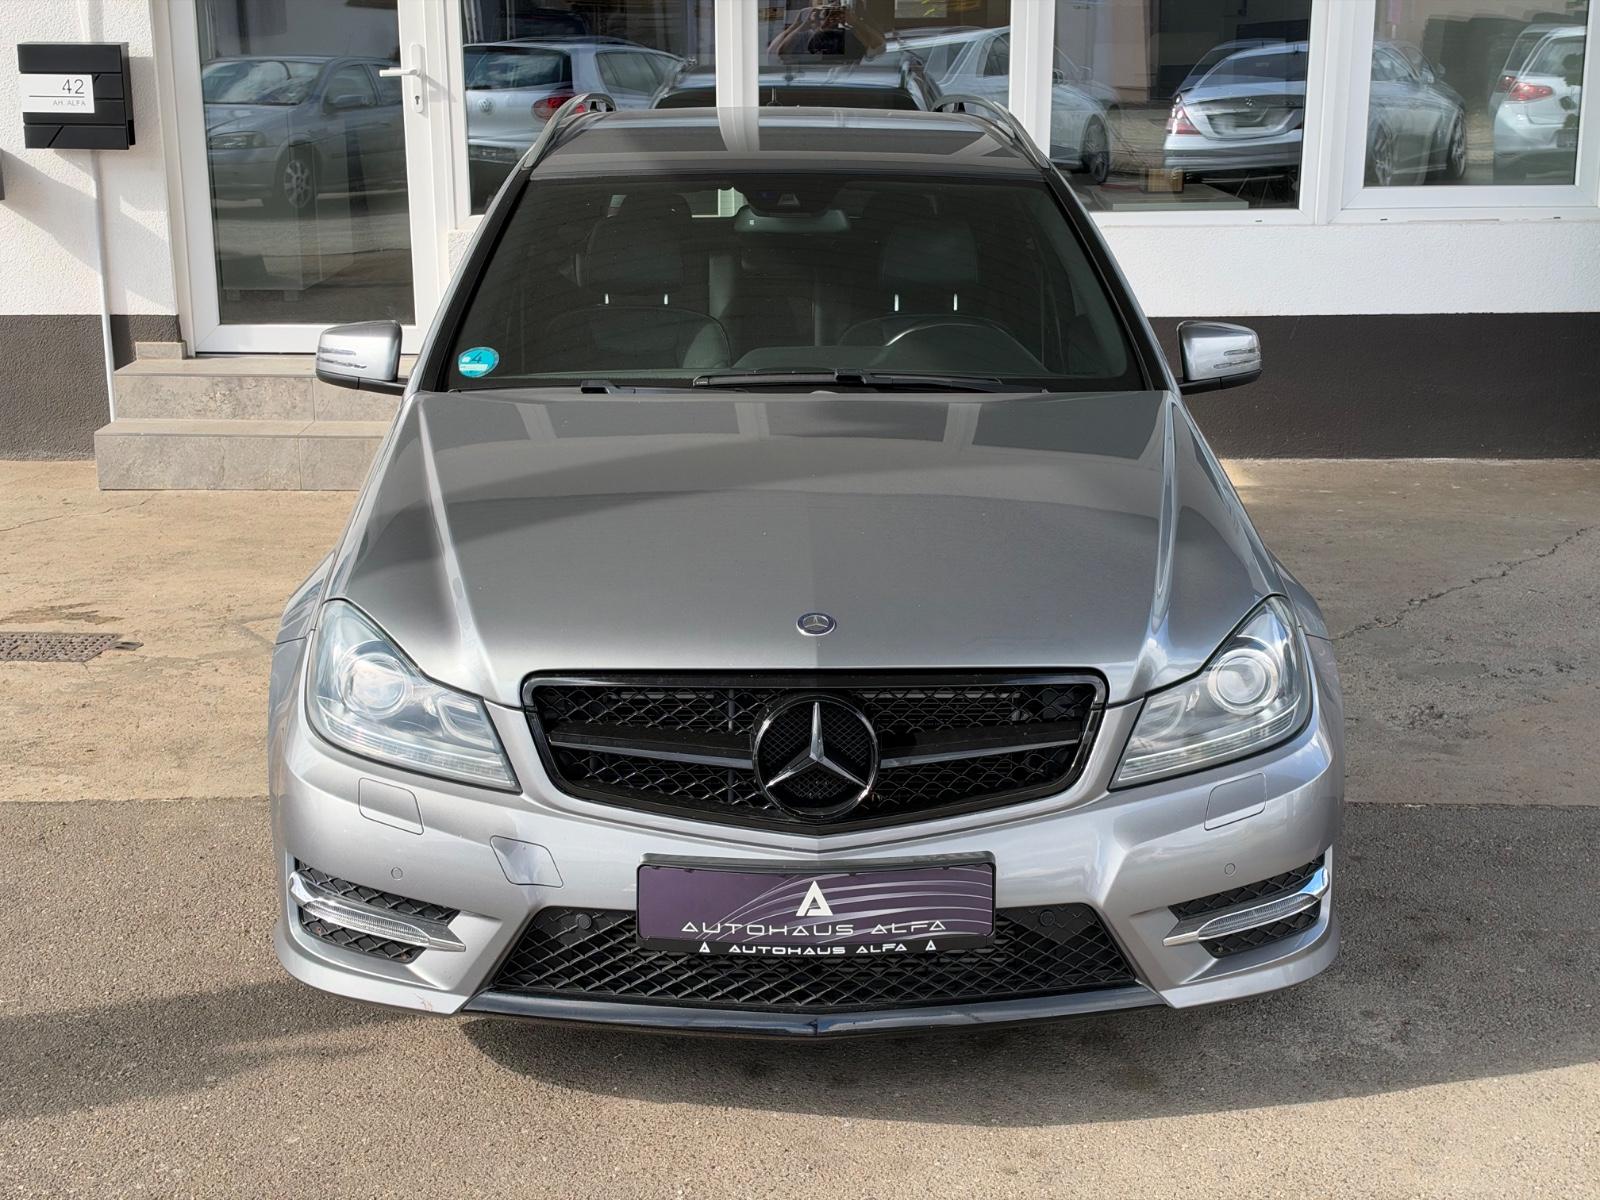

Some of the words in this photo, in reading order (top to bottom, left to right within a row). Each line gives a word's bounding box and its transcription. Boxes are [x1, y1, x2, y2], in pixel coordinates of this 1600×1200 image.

[62, 78, 85, 95] 42
[470, 351, 482, 364] 4
[681, 921, 854, 936] AUTOHAUS
[871, 919, 947, 935] ALFA
[728, 944, 846, 956] AUTOHAUS
[855, 943, 907, 954] ALFA
